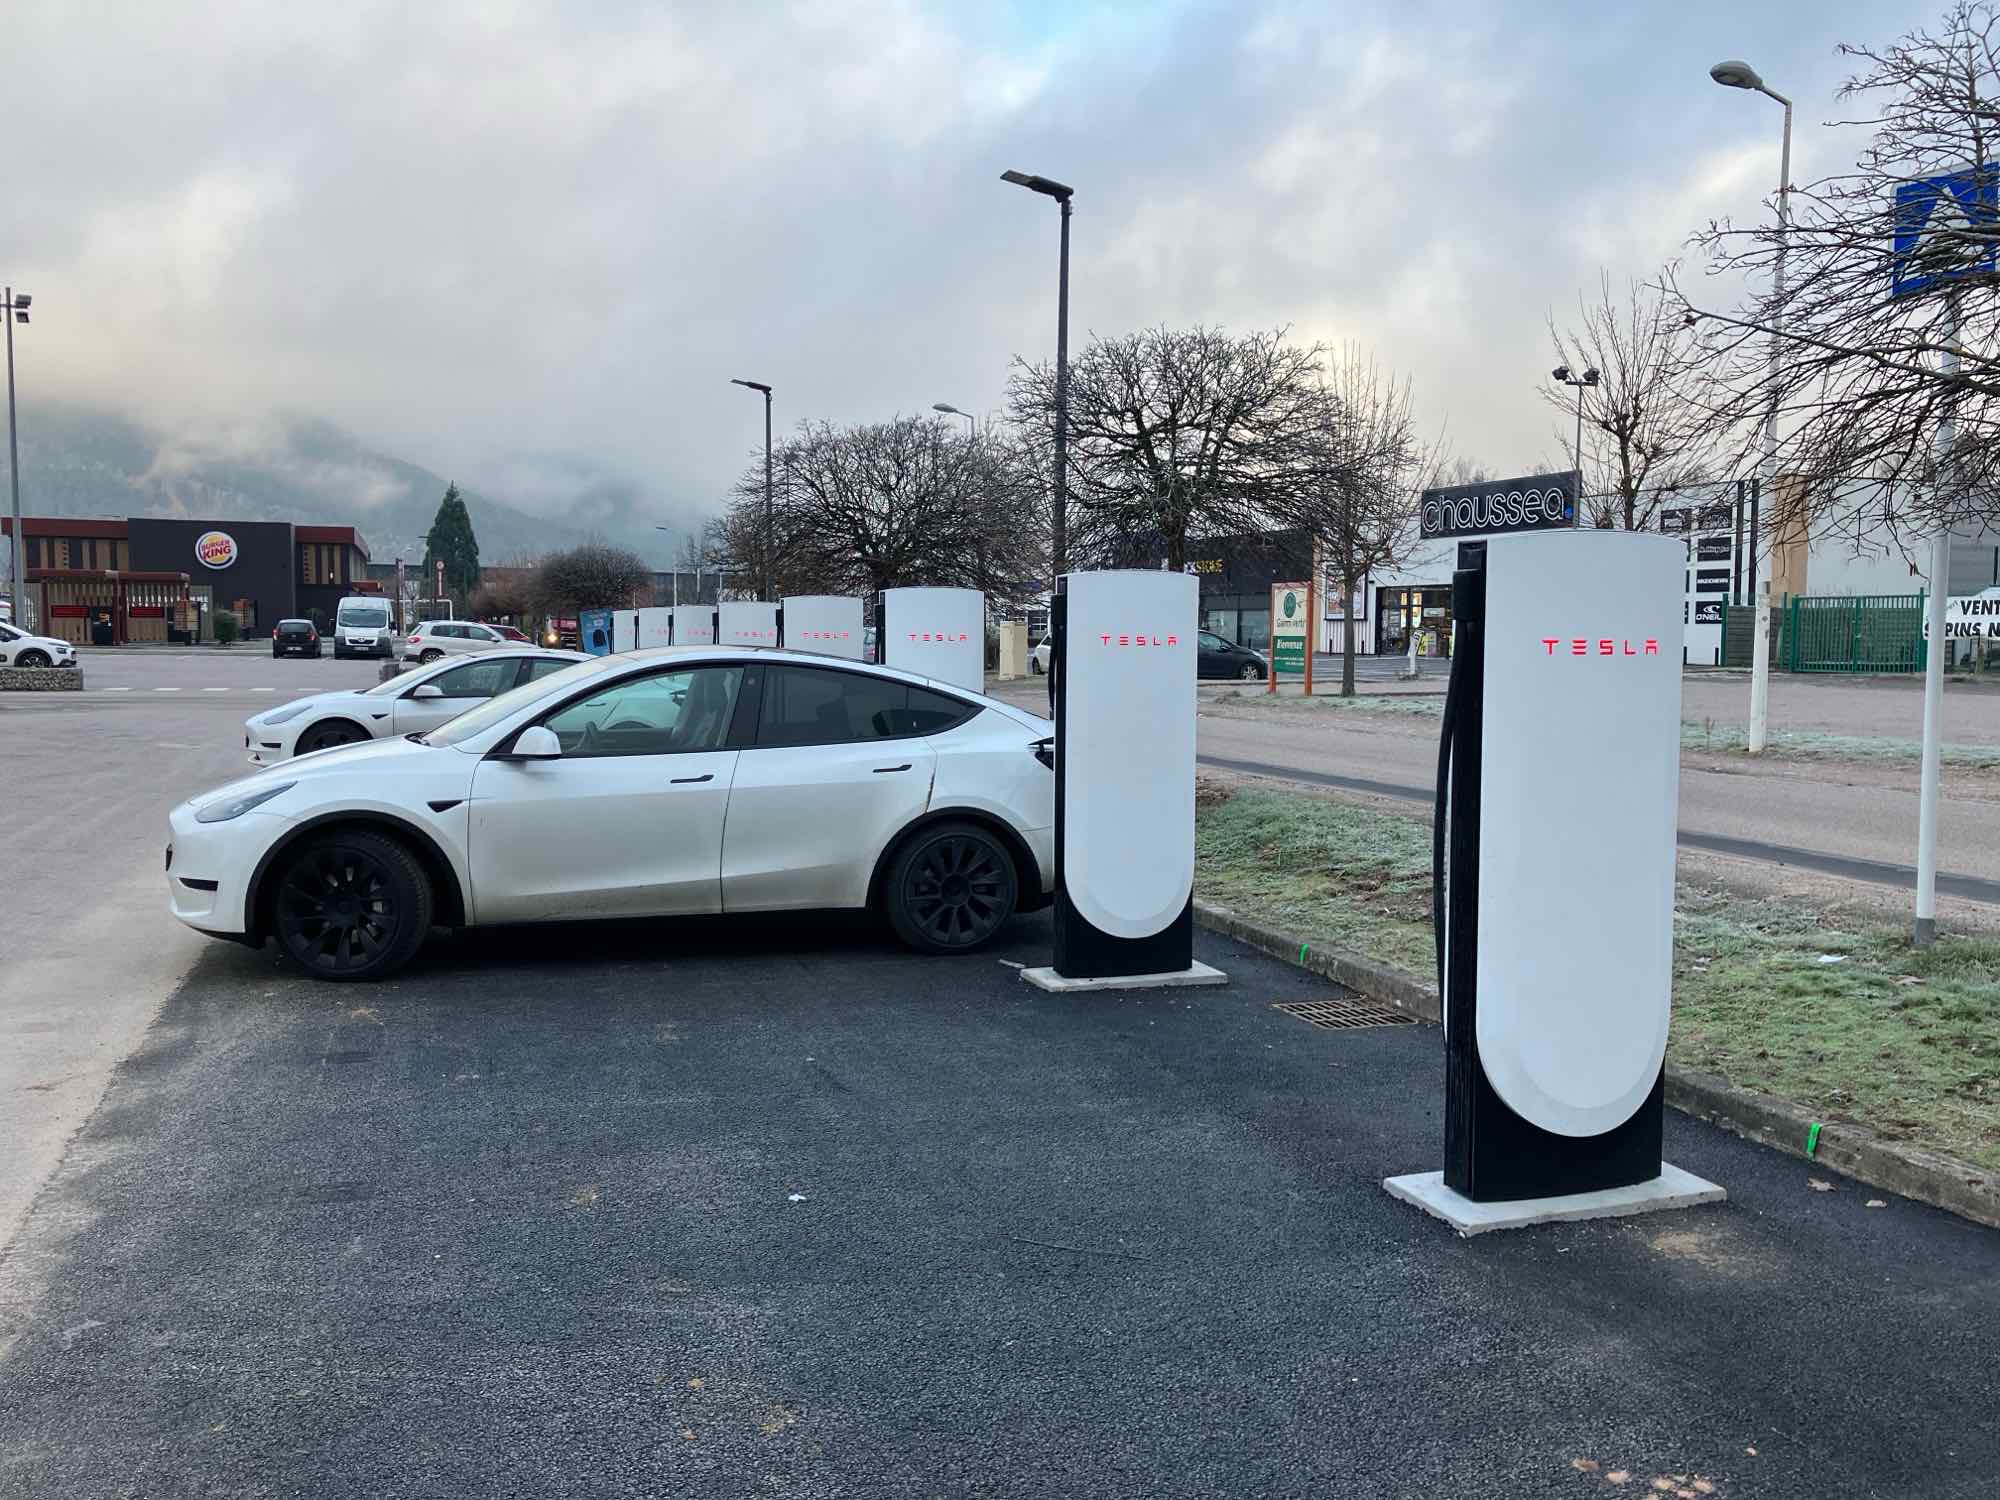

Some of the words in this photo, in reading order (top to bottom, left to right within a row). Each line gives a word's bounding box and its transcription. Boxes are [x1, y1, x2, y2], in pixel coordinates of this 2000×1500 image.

[1423, 487, 1565, 533] chaussea
[201, 539, 231, 551] BURGER
[202, 545, 232, 560] KING
[801, 632, 849, 640] TESLA
[908, 633, 968, 641] TESLA
[1100, 635, 1178, 646] TESLA
[1540, 639, 1658, 656] TESLA
